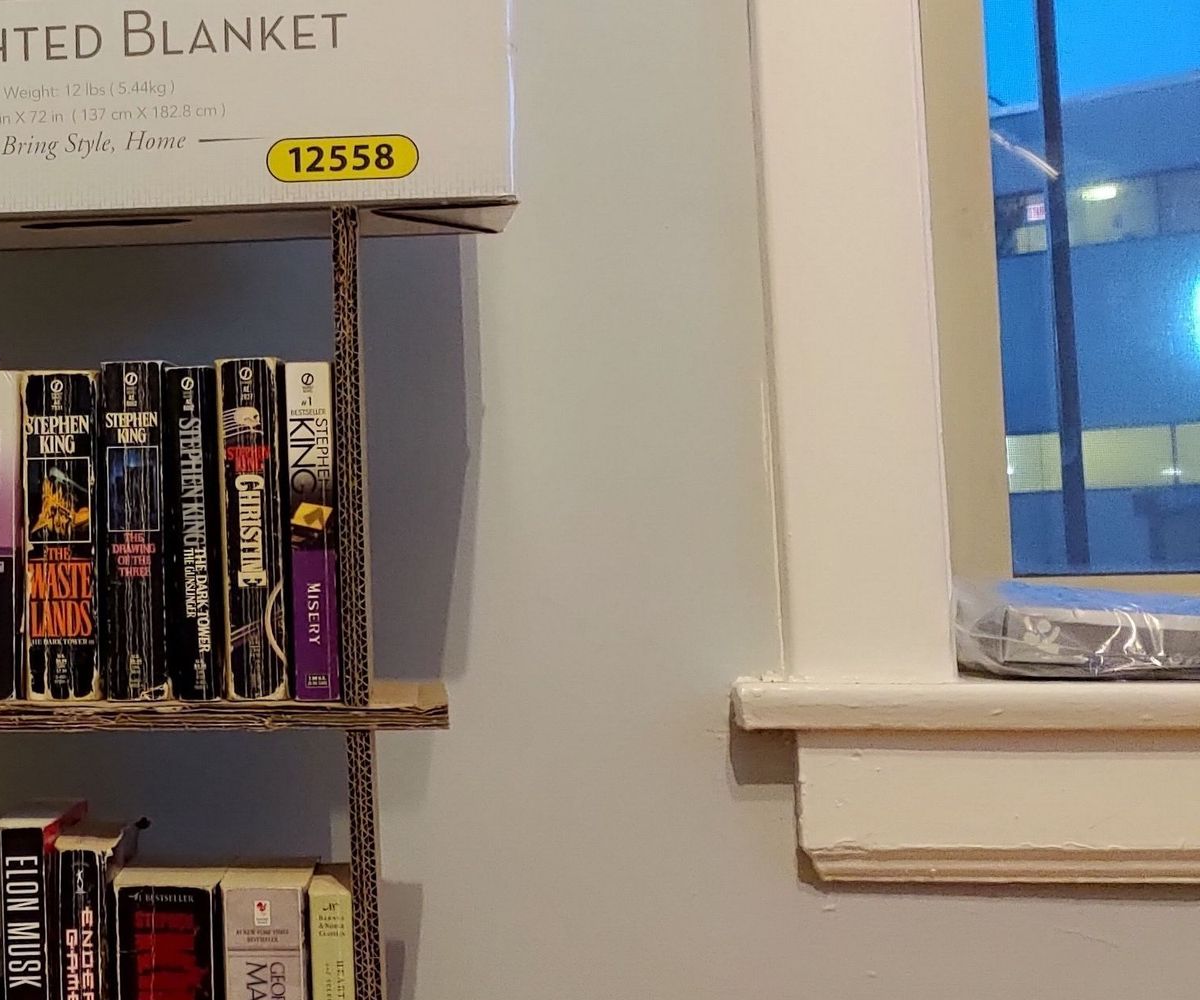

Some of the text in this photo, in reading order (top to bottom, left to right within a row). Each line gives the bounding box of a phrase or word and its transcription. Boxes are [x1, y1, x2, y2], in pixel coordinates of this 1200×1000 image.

[122, 10, 348, 57] BLANKET
[3, 85, 59, 101] Weight:
[65, 84, 80, 97] 12
[84, 83, 106, 97] lbs
[0, 112, 11, 124] in
[29, 110, 49, 123] 72
[52, 110, 64, 122] in
[112, 110, 133, 121] cm
[153, 106, 191, 119] 182.8
[1, 130, 187, 161] Bring Style, Home
[289, 143, 395, 173] 12558
[24, 415, 89, 435] STEPHEN
[105, 412, 158, 428] STEPHEN
[290, 408, 327, 416] BESTSELLER
[39, 434, 76, 454] KING
[117, 428, 147, 443] KING
[179, 417, 204, 498] STEPHEN
[289, 418, 317, 494] KING
[124, 533, 144, 543] THE
[182, 500, 207, 548] KING
[235, 474, 267, 588] CHRISTINE
[46, 547, 70, 560] THE
[112, 543, 156, 554] DRAWING
[195, 547, 207, 572] THE
[28, 562, 93, 599] WASTE
[118, 566, 151, 577] THREE
[184, 548, 198, 618] THE GUNSLINGER
[196, 574, 208, 607] DARK
[30, 600, 93, 638] LANDS
[307, 581, 322, 645] MISERY
[198, 608, 211, 653] TOWER
[145, 893, 194, 903] BESTSELLER
[4, 855, 41, 990] ELON MUSK
[336, 960, 345, 999] HEART
